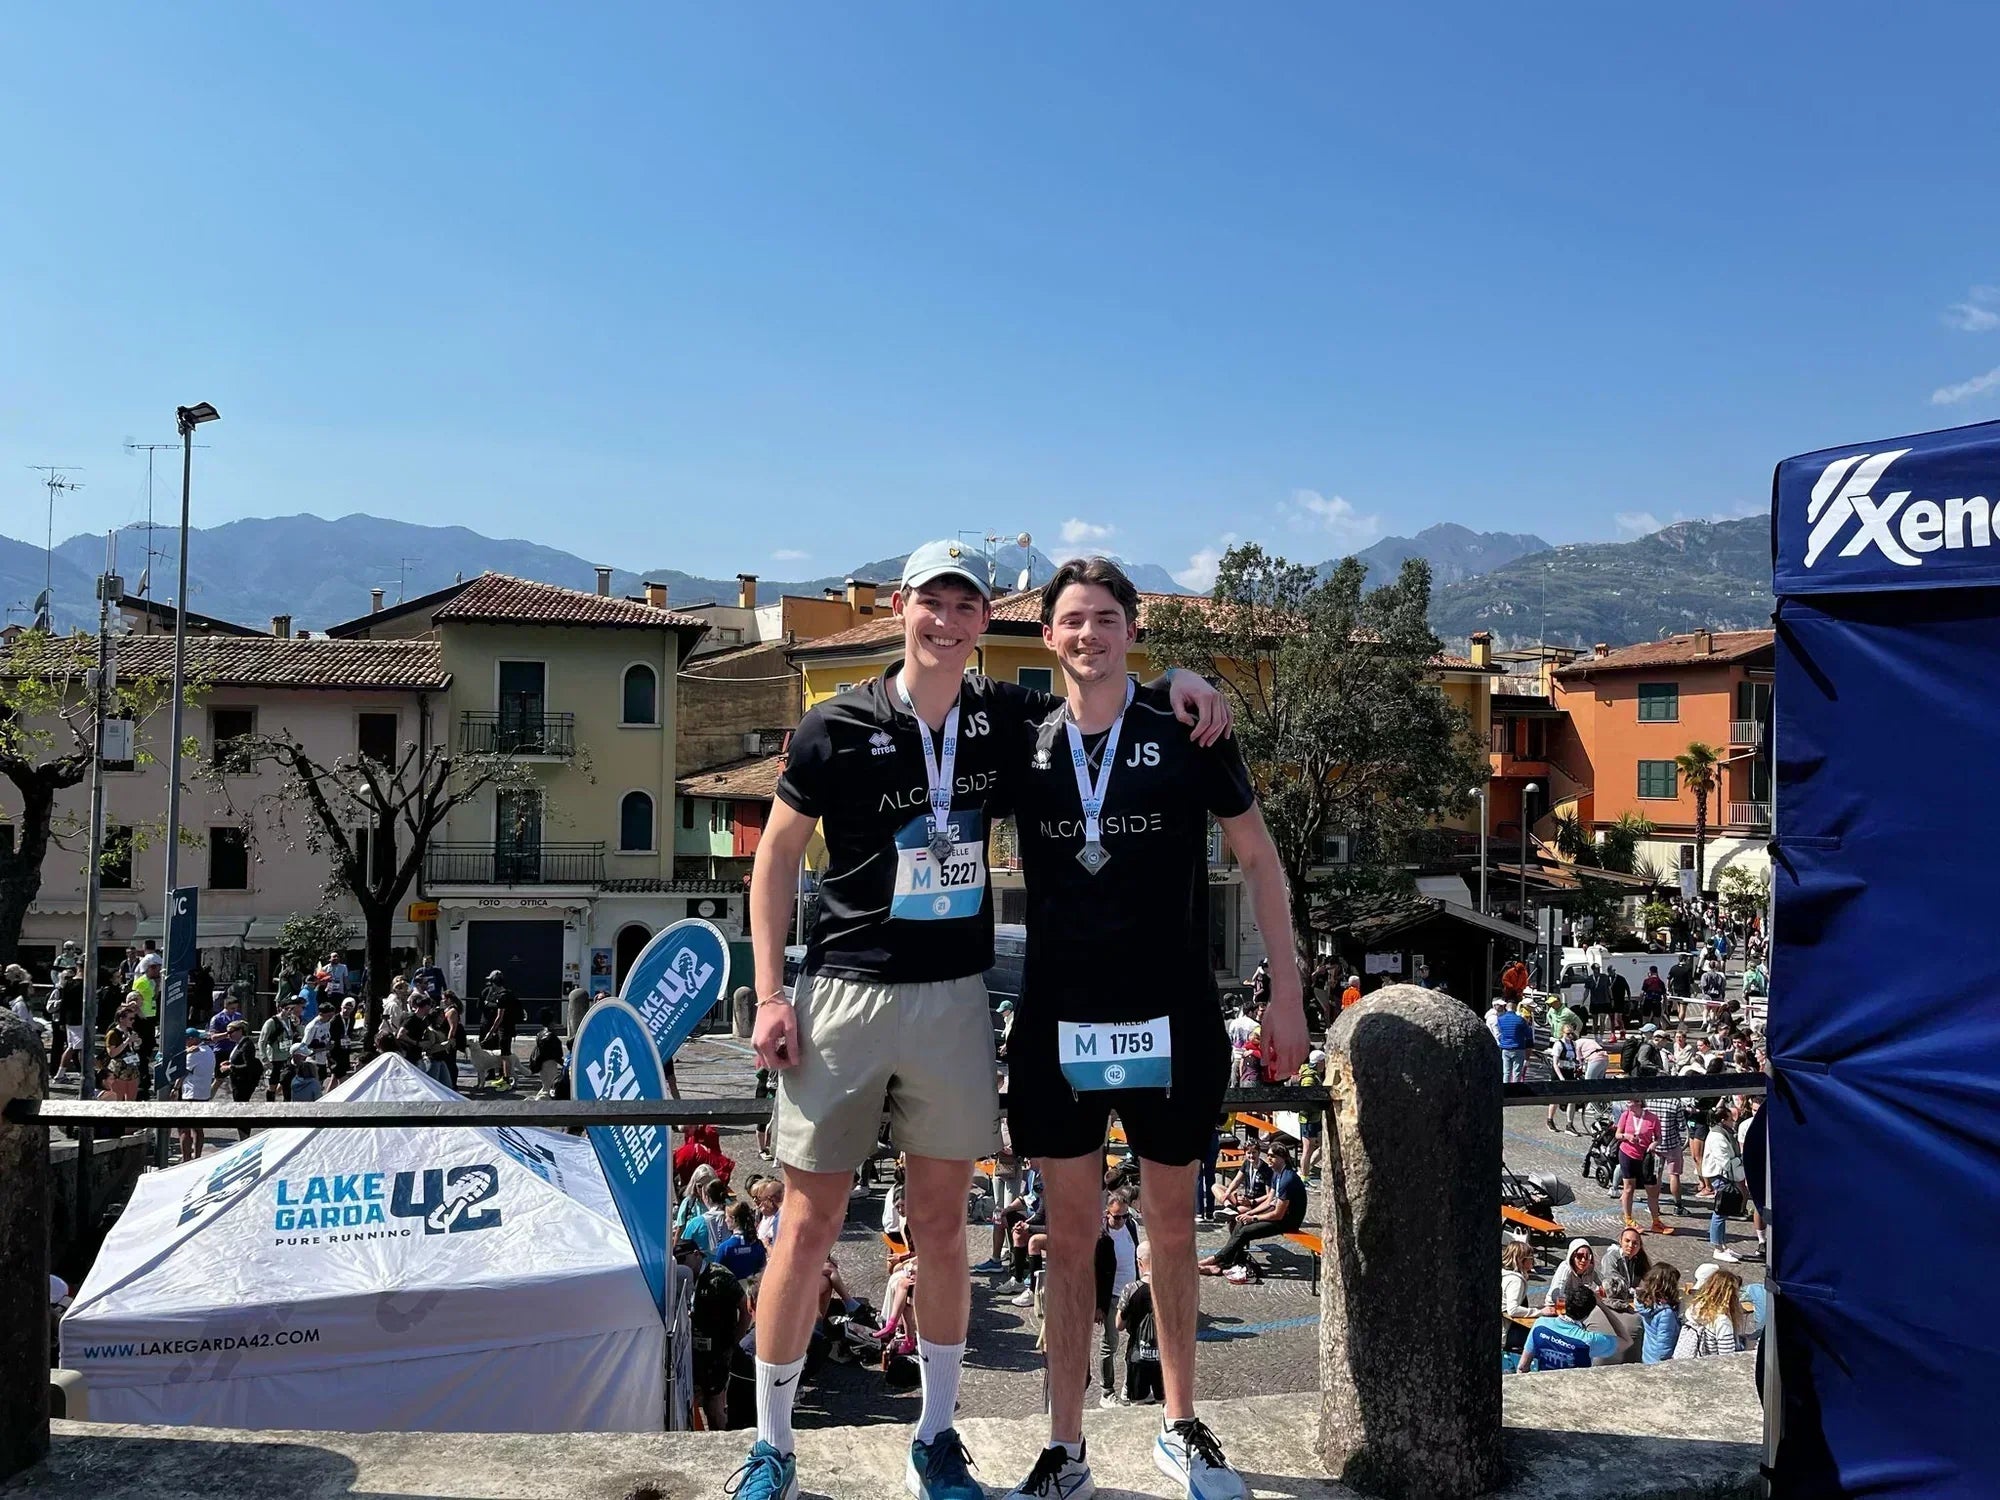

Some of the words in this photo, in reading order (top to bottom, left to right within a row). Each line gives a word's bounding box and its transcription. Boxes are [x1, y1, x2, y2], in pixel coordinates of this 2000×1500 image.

[1837, 490, 2000, 566] Xen
[964, 710, 991, 738] JS
[1072, 748, 1083, 758] 20
[1074, 757, 1085, 767] 25
[1126, 741, 1161, 768] JS
[878, 770, 998, 812] ALCSIDE
[949, 847, 969, 857] ELLE
[912, 866, 931, 890] M
[940, 861, 977, 887] 5227
[639, 990, 664, 1024] KE
[650, 1003, 676, 1036] RDA
[1075, 1032, 1097, 1056] M
[1110, 1031, 1154, 1055] 1759
[1109, 1070, 1121, 1080] 42
[277, 1172, 385, 1206] LAKE
[390, 1163, 503, 1236] 42
[275, 1203, 385, 1231] GARDA
[275, 1236, 321, 1247] PURE
[329, 1228, 412, 1244] RUNNING
[83, 1328, 320, 1360] WWW.LAKEGARDA42.COM
